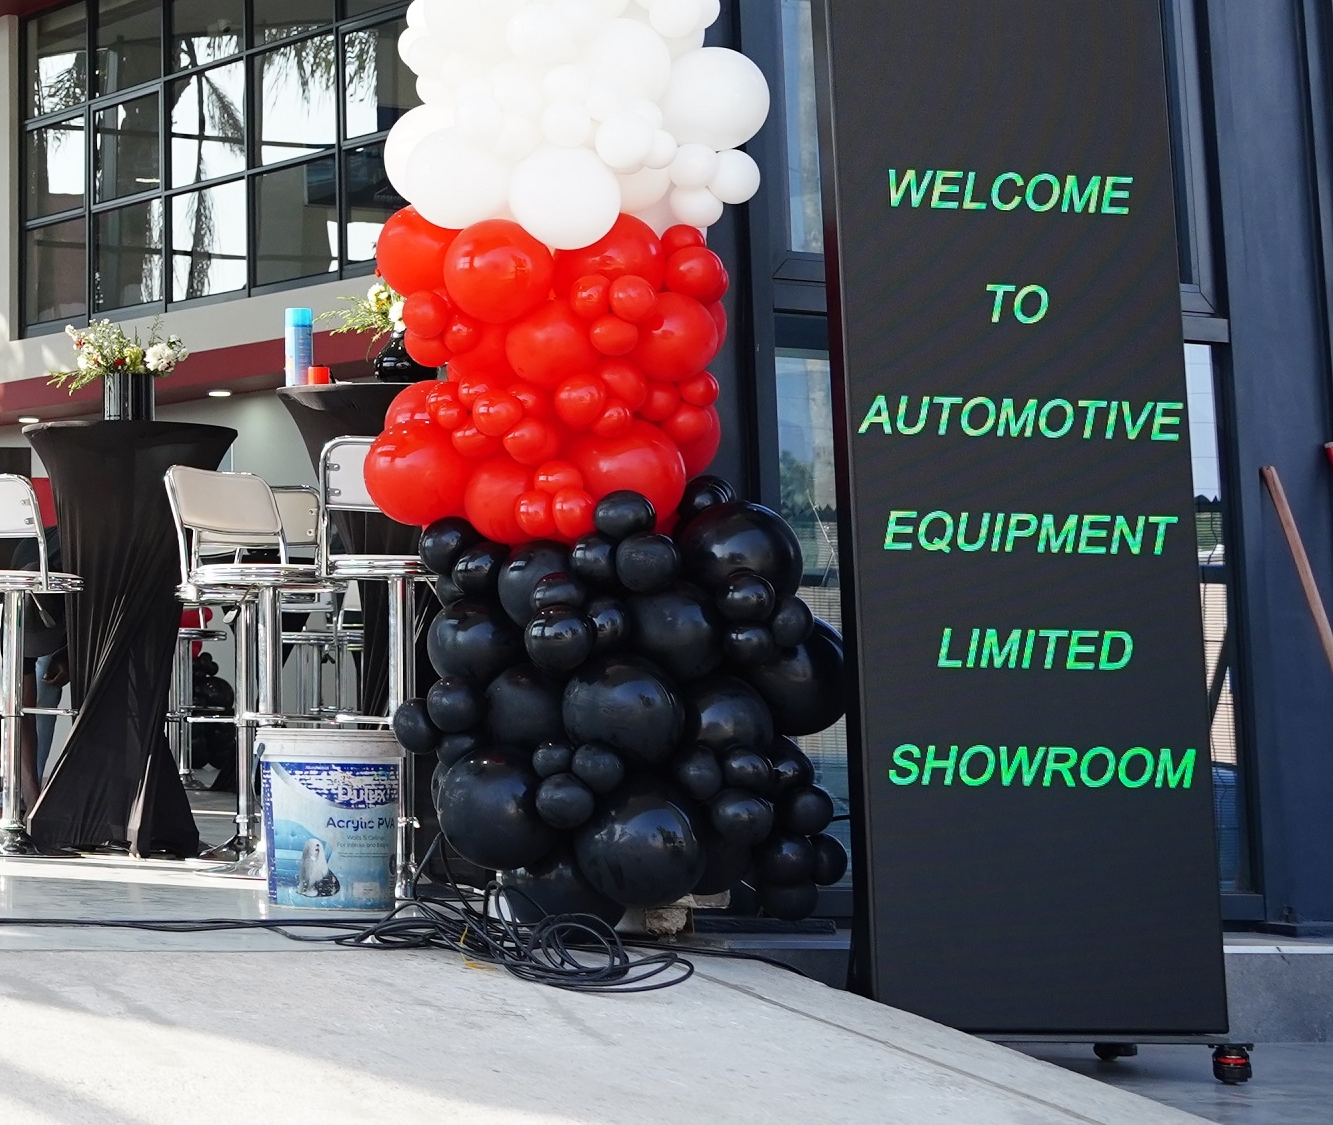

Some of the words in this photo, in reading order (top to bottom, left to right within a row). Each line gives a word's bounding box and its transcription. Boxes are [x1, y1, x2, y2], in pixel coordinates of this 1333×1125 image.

[888, 168, 1134, 215] WELCOME
[986, 283, 1050, 324] TO
[857, 395, 1184, 442] AUTOMOTIVE
[883, 510, 1179, 556] EQUIPMENT
[937, 627, 1134, 671] LIMITED
[888, 743, 1196, 789] SHOWROOM
[377, 817, 395, 829] PVA
